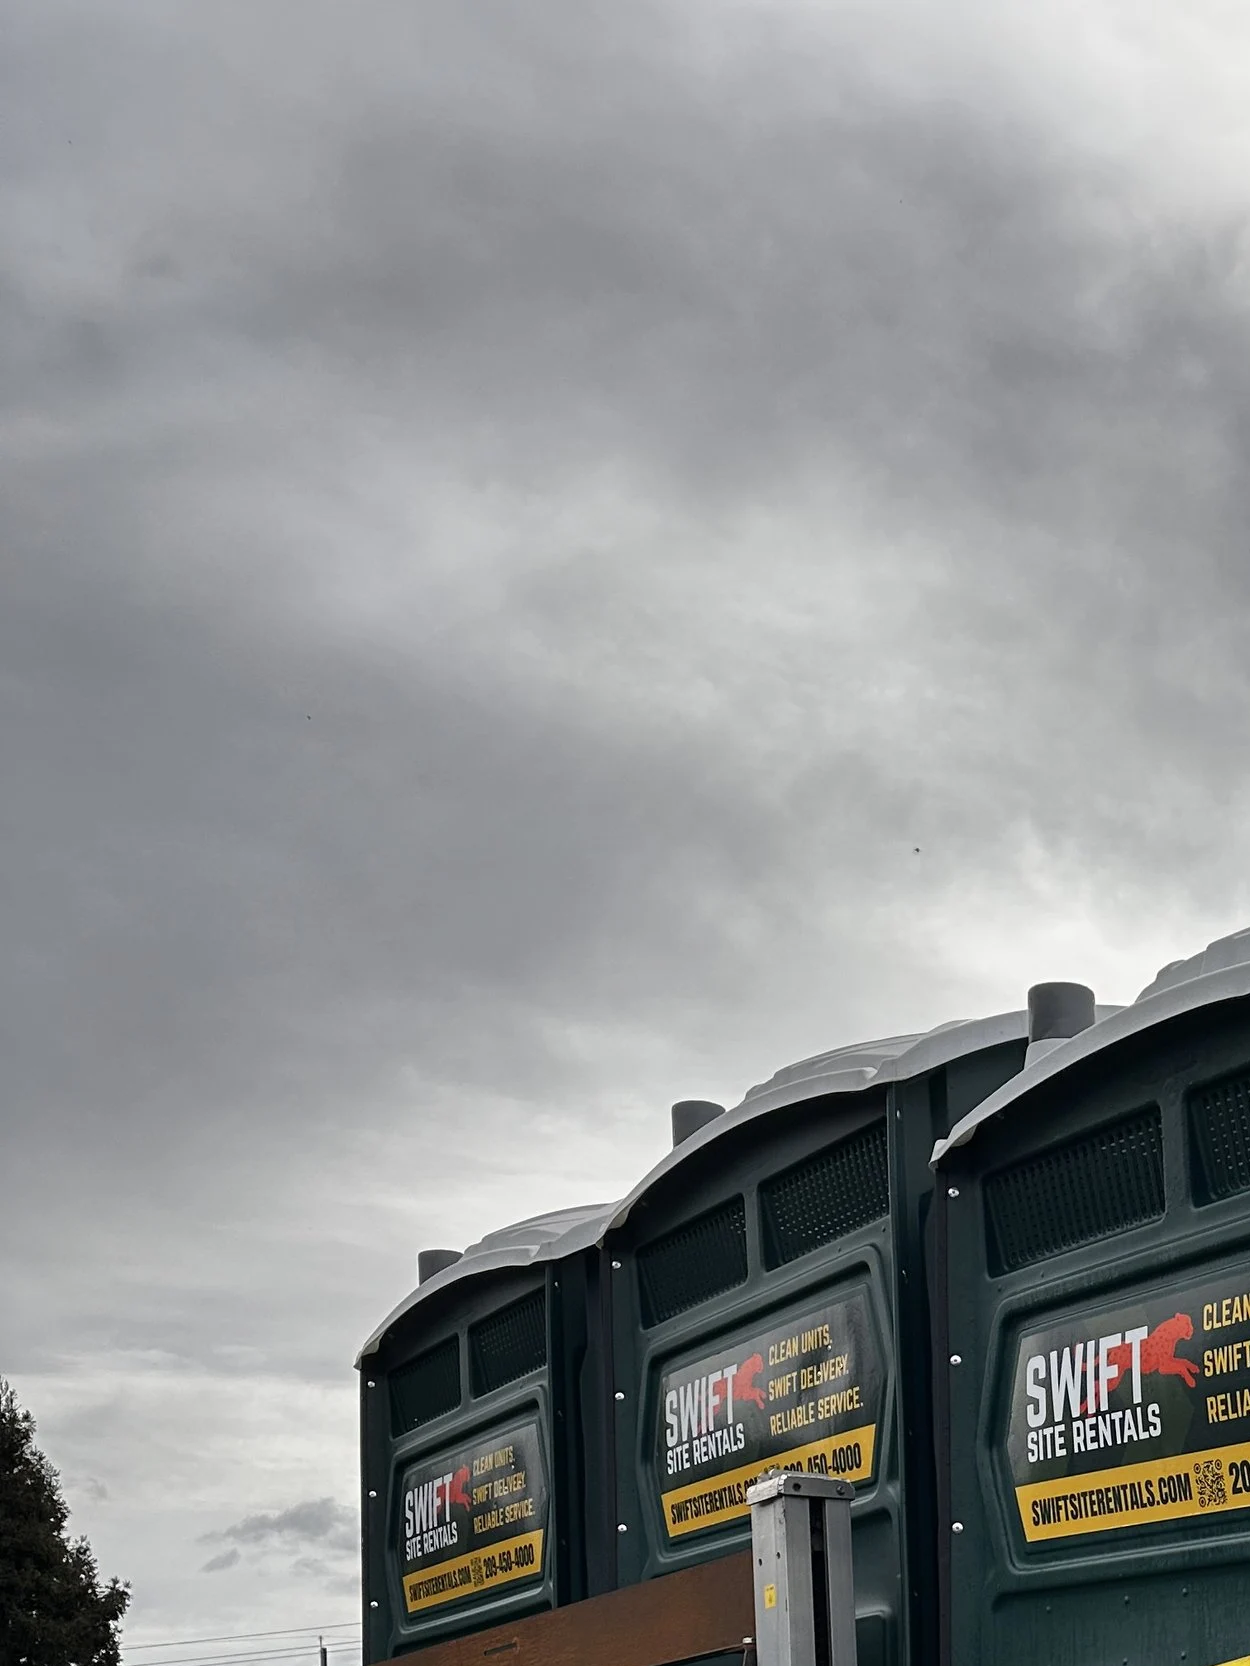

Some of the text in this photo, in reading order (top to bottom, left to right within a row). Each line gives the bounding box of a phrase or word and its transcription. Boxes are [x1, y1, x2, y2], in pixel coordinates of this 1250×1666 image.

[769, 1324, 833, 1366] CLEAN UNITS.
[769, 1354, 849, 1401] SWIFT DELIVERY.
[1026, 1325, 1149, 1428] SWIFT
[665, 1364, 737, 1447] SWIFT
[770, 1387, 864, 1436] RELIABLE SERVICE.
[667, 1422, 745, 1475] SITE RENTALS
[1026, 1402, 1162, 1464] SITE RENTALS
[473, 1453, 493, 1476] CLEAN
[405, 1472, 453, 1539] SWIFT
[473, 1483, 492, 1505] SWIFT
[1031, 1471, 1194, 1528] SWIFTSITERENTALS.COM
[407, 1522, 458, 1561] SITE RENTALS
[474, 1509, 503, 1534] RELIABLE
[409, 1544, 534, 1602] SWIFTSITERENTALS.COM 209-450-4000
